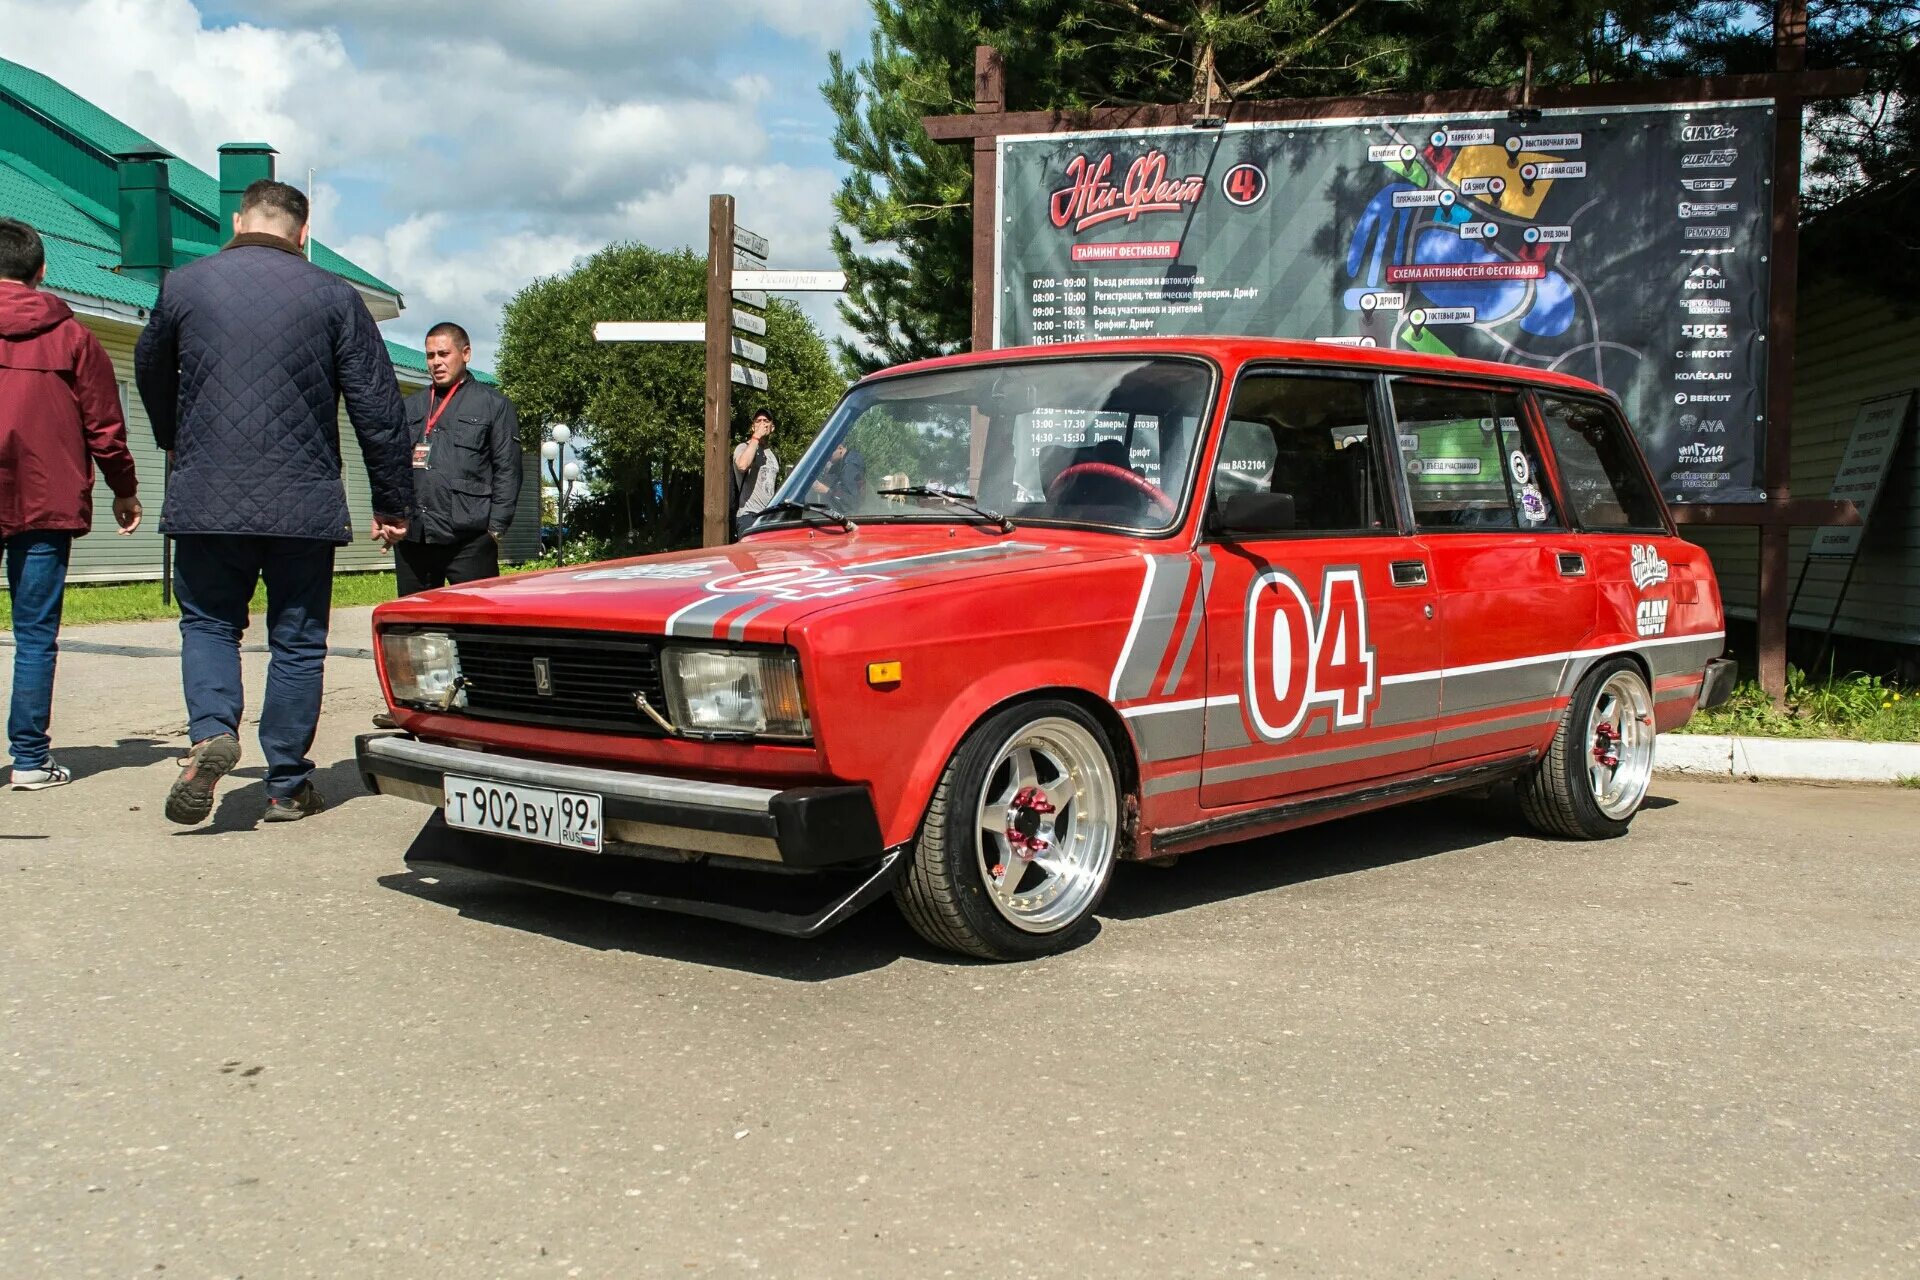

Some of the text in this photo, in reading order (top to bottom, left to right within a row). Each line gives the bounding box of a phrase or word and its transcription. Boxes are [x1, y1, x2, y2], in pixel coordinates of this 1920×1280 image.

[1525, 139, 1563, 147] ВЫСТАВОЧНАЯ
[1566, 166, 1583, 174] СЦЕНА
[1231, 170, 1255, 200] 4
[1078, 244, 1170, 258] ТАЙМИНГ ФЕСТИВАЛЯ
[1394, 266, 1538, 279] СХЕМА АКТИВНОСТЕЙ ФЕСТИВАЛЯ
[1033, 279, 1054, 288] 07:00
[1064, 278, 1086, 288] 09:00
[1094, 277, 1116, 288] Въезд
[1118, 278, 1152, 288] регионов
[1160, 276, 1204, 286] автоклубов
[1684, 279, 1726, 289] Red Bull
[1033, 293, 1054, 302] 08:00
[1064, 292, 1086, 302] 10:00
[1095, 291, 1144, 302] Регистрация,
[1145, 291, 1192, 300] технические
[1193, 290, 1232, 300] проверки.
[1233, 287, 1258, 299] Дрифт
[1380, 296, 1400, 306] ДРИФТ
[1033, 308, 1054, 316] 09:00
[1064, 306, 1086, 316] 18:00
[1093, 306, 1116, 316] Въезд
[1118, 306, 1160, 316] участников
[1168, 304, 1202, 315] зрителей
[1033, 322, 1054, 330] 10:00
[1063, 320, 1085, 330] 10:15
[1094, 320, 1128, 331] Брифинг.
[1129, 318, 1154, 330] Дрифт
[1032, 336, 1054, 345] 10:15
[1032, 420, 1054, 428] 13:00
[1064, 420, 1086, 428] 17.30
[1094, 420, 1127, 430] Замеры.
[1698, 420, 1726, 432] AYA
[1032, 434, 1053, 442] 14:30
[1063, 434, 1086, 442] 15:30
[1232, 460, 1246, 470] ВАЗ
[1248, 460, 1266, 470] 2104
[1247, 570, 1374, 739] 04
[562, 797, 588, 831] 99
[562, 830, 581, 843] RUS
